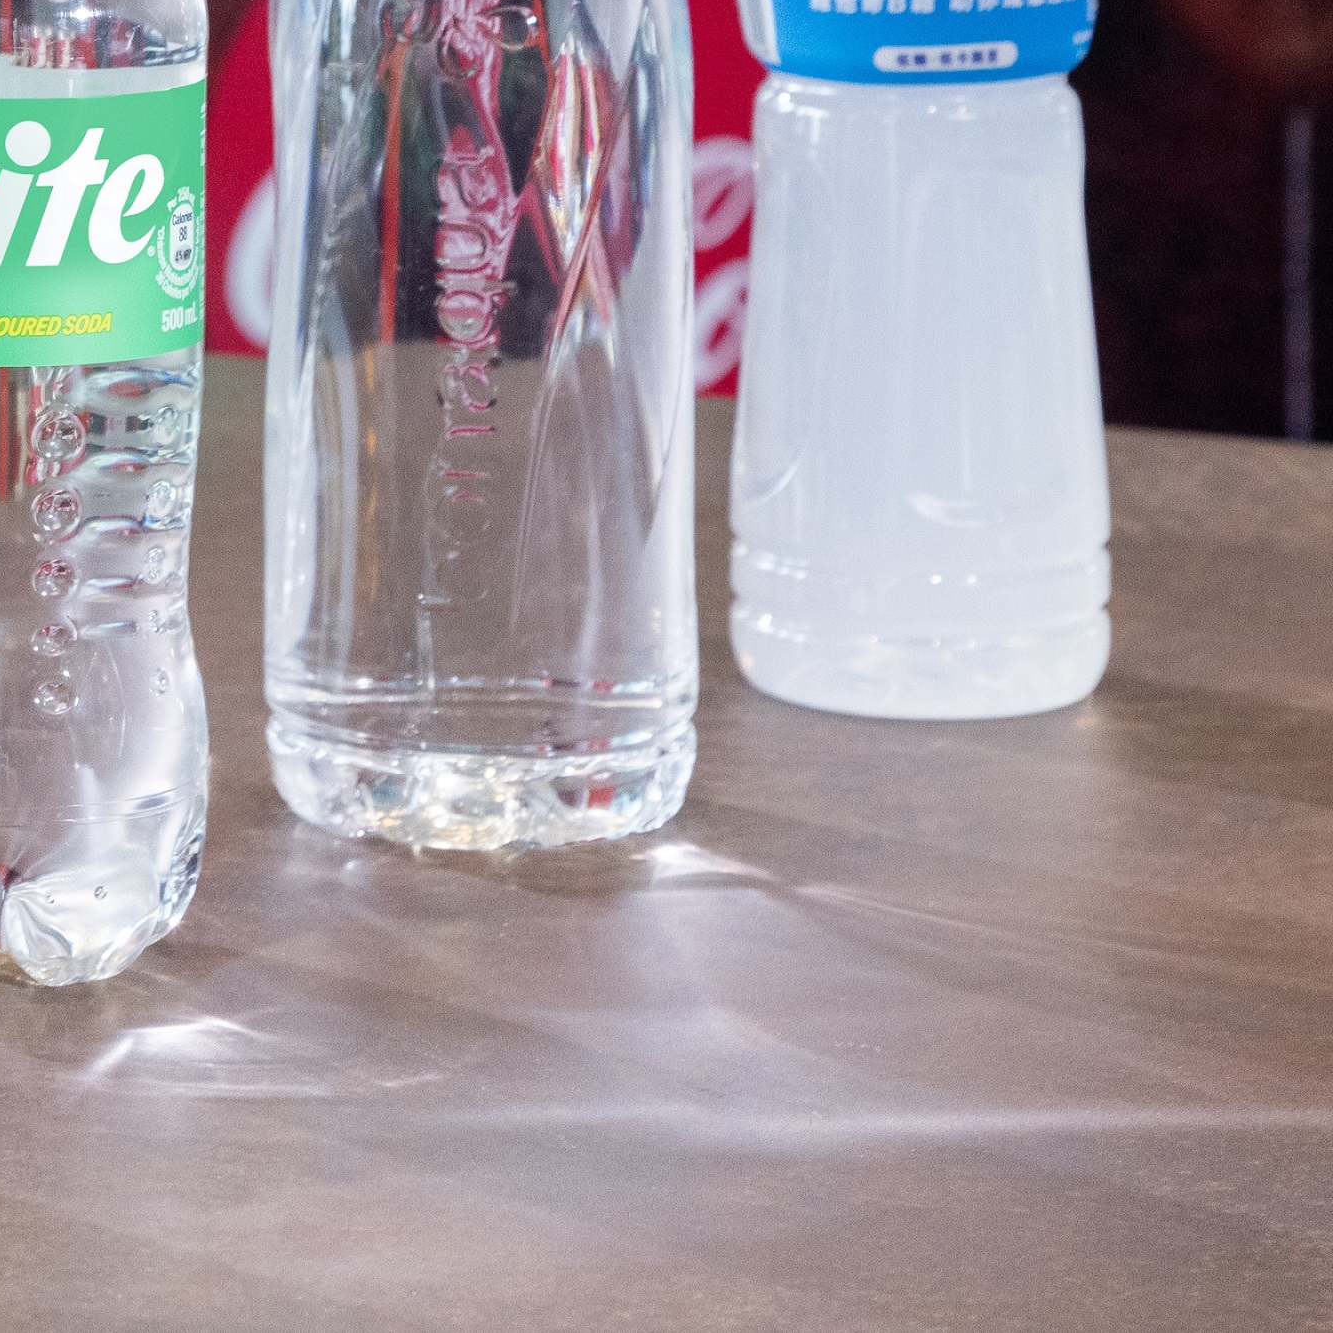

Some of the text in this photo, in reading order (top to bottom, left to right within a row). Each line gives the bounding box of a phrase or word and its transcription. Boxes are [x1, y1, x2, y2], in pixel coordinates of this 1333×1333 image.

[172, 212, 193, 226] Calories
[178, 226, 188, 242] 88
[62, 312, 113, 336] SODA
[161, 301, 198, 333] 500 mL
